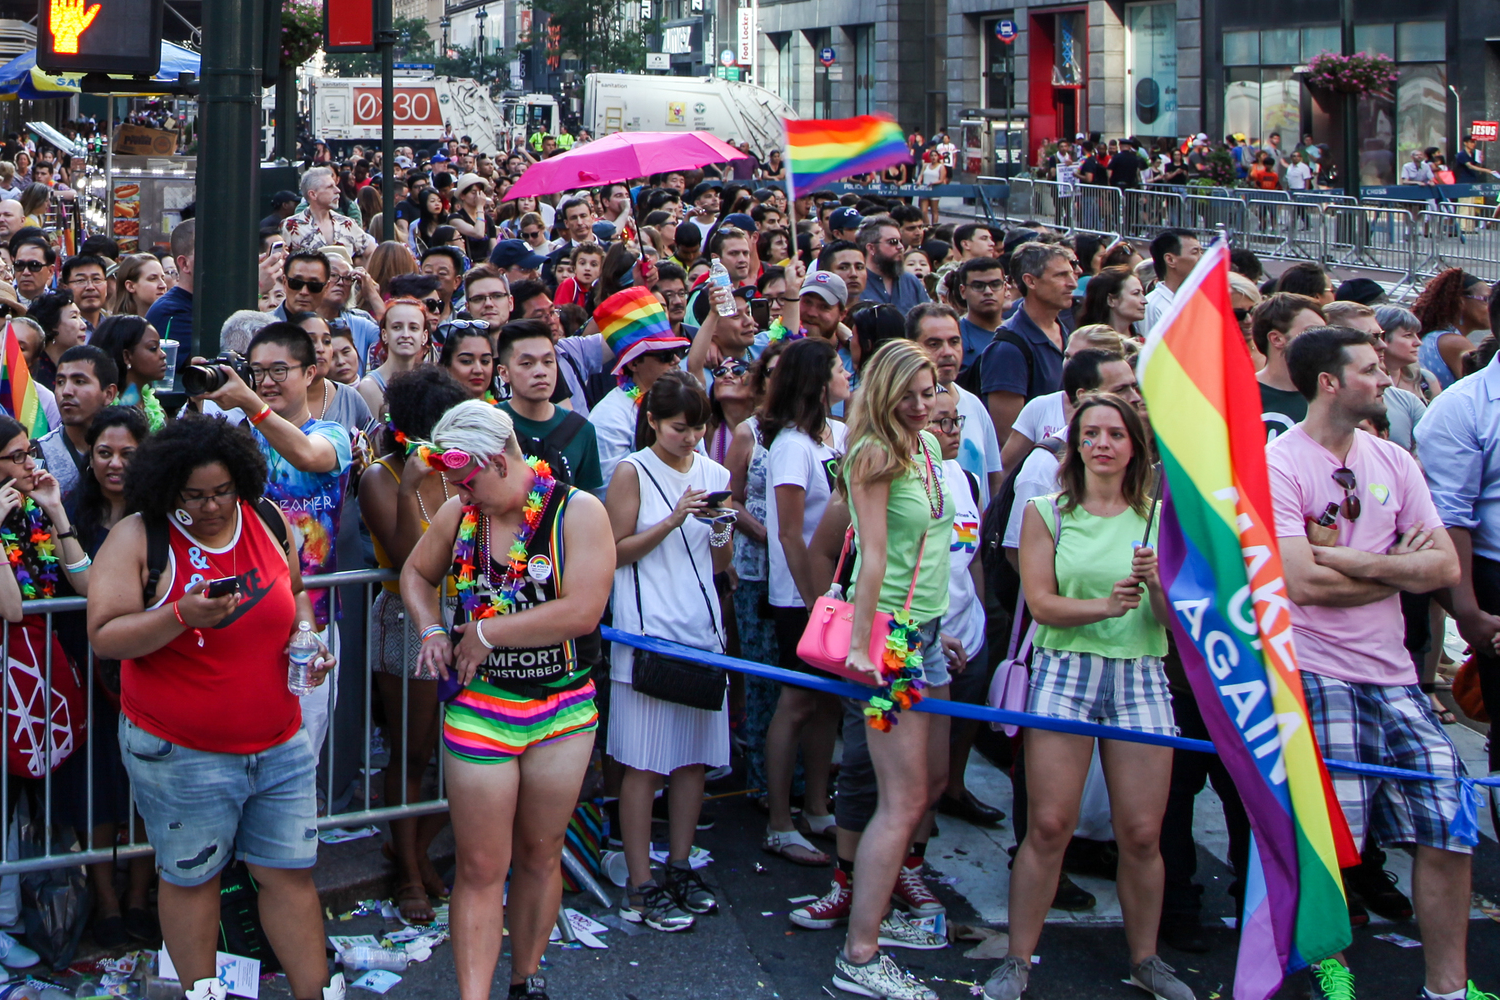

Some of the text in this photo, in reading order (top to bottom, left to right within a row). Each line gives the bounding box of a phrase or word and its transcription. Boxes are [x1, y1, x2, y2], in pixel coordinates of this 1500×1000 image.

[741, 12, 750, 60] Foot Locker
[1472, 125, 1497, 136] JESUS
[1366, 187, 1388, 195] CROSS
